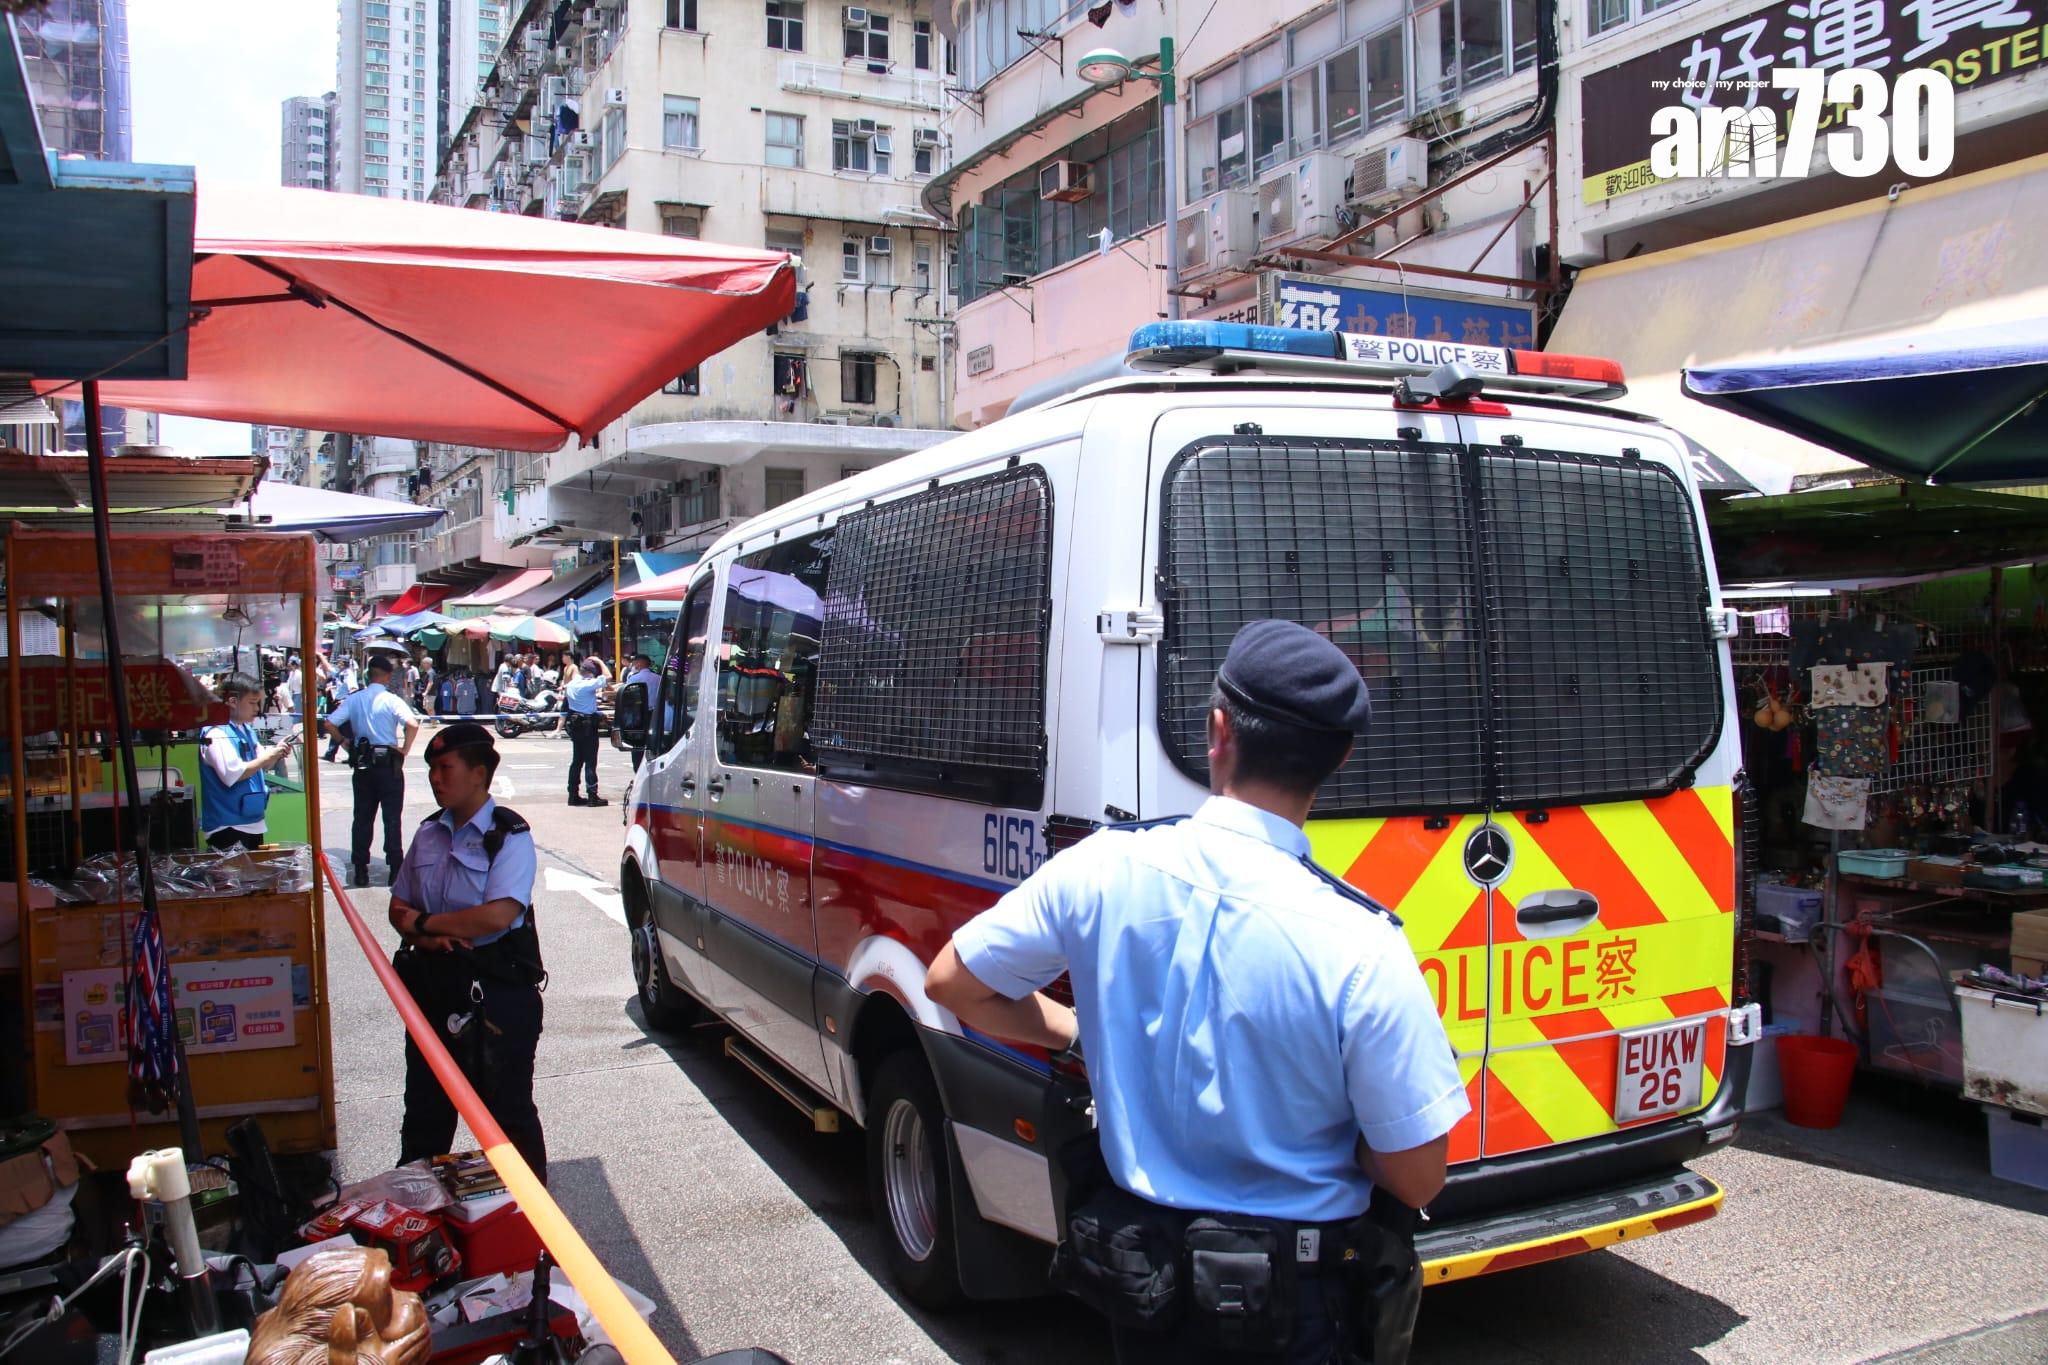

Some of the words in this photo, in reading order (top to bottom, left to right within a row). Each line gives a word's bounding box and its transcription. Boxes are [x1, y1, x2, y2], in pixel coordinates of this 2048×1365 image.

[1351, 338, 1384, 360] 警
[1388, 340, 1468, 366] POLICE
[1471, 349, 1502, 371] 察
[984, 813, 1035, 881] 6163
[727, 845, 774, 907] POLICE
[1418, 940, 1590, 1022] OLICE
[1596, 935, 1638, 1001] 察
[1624, 1026, 1700, 1077] EUKW
[1638, 1068, 1683, 1112] 26
